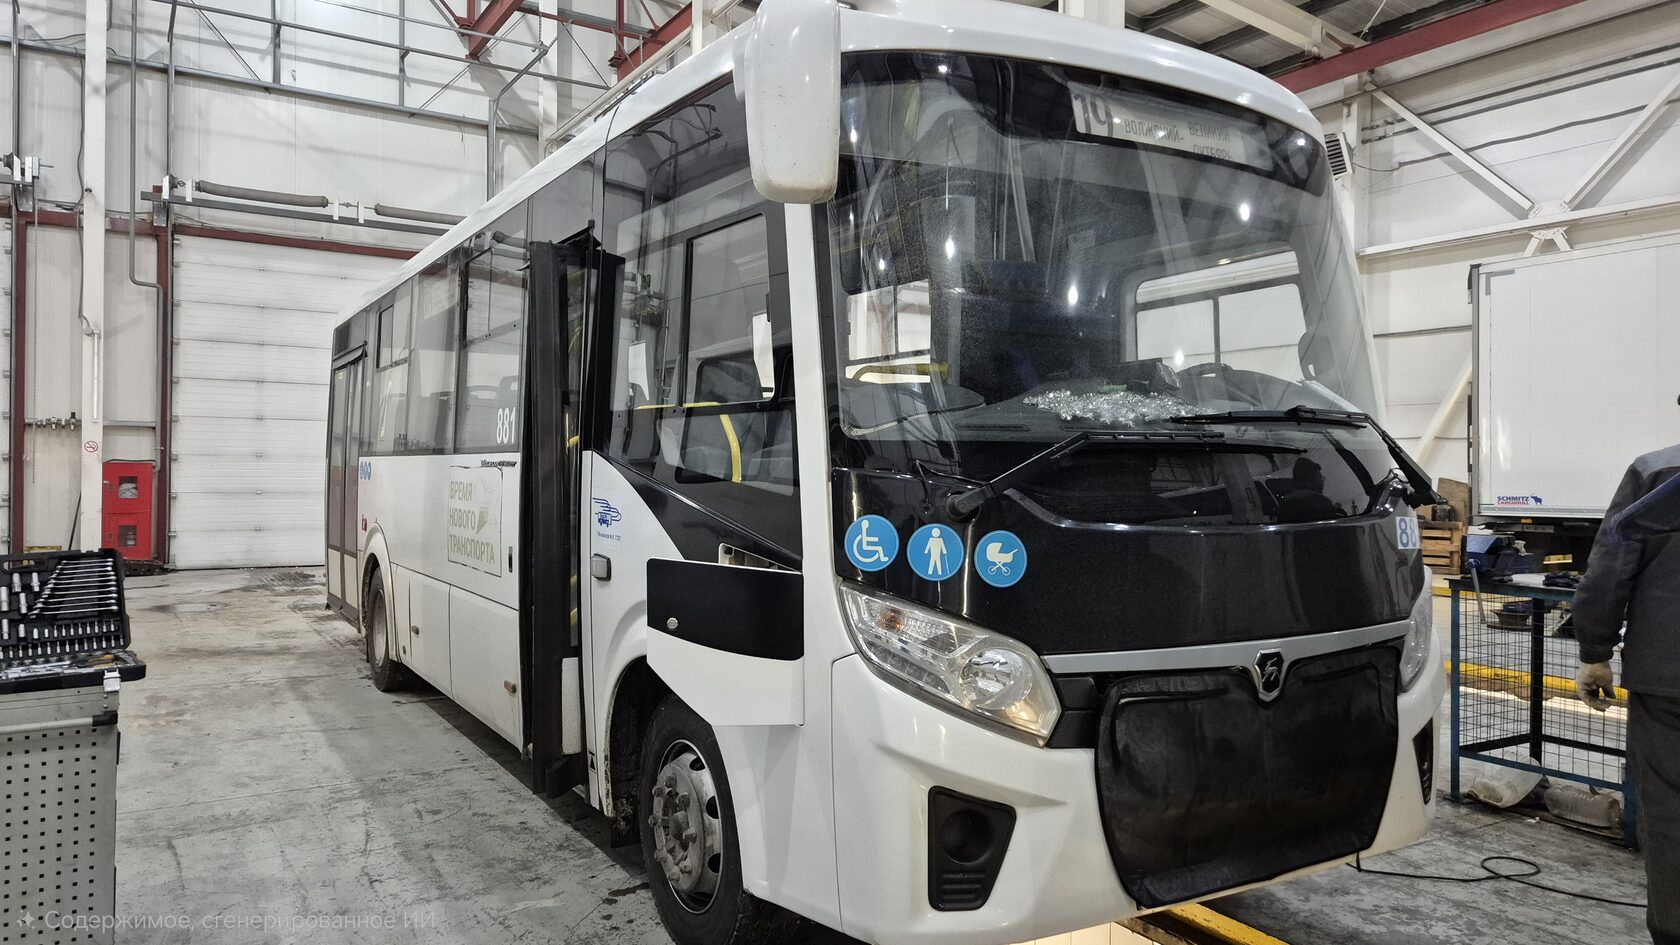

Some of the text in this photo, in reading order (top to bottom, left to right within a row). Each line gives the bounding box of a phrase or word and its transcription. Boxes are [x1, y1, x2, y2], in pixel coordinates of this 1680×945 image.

[1074, 93, 1114, 138] 19
[497, 407, 516, 444] 881
[450, 480, 473, 501] ВРЕМЯ
[449, 507, 476, 531] НОВОГО
[1398, 517, 1417, 548] 88
[449, 534, 495, 564] ТРАНСПОРТА
